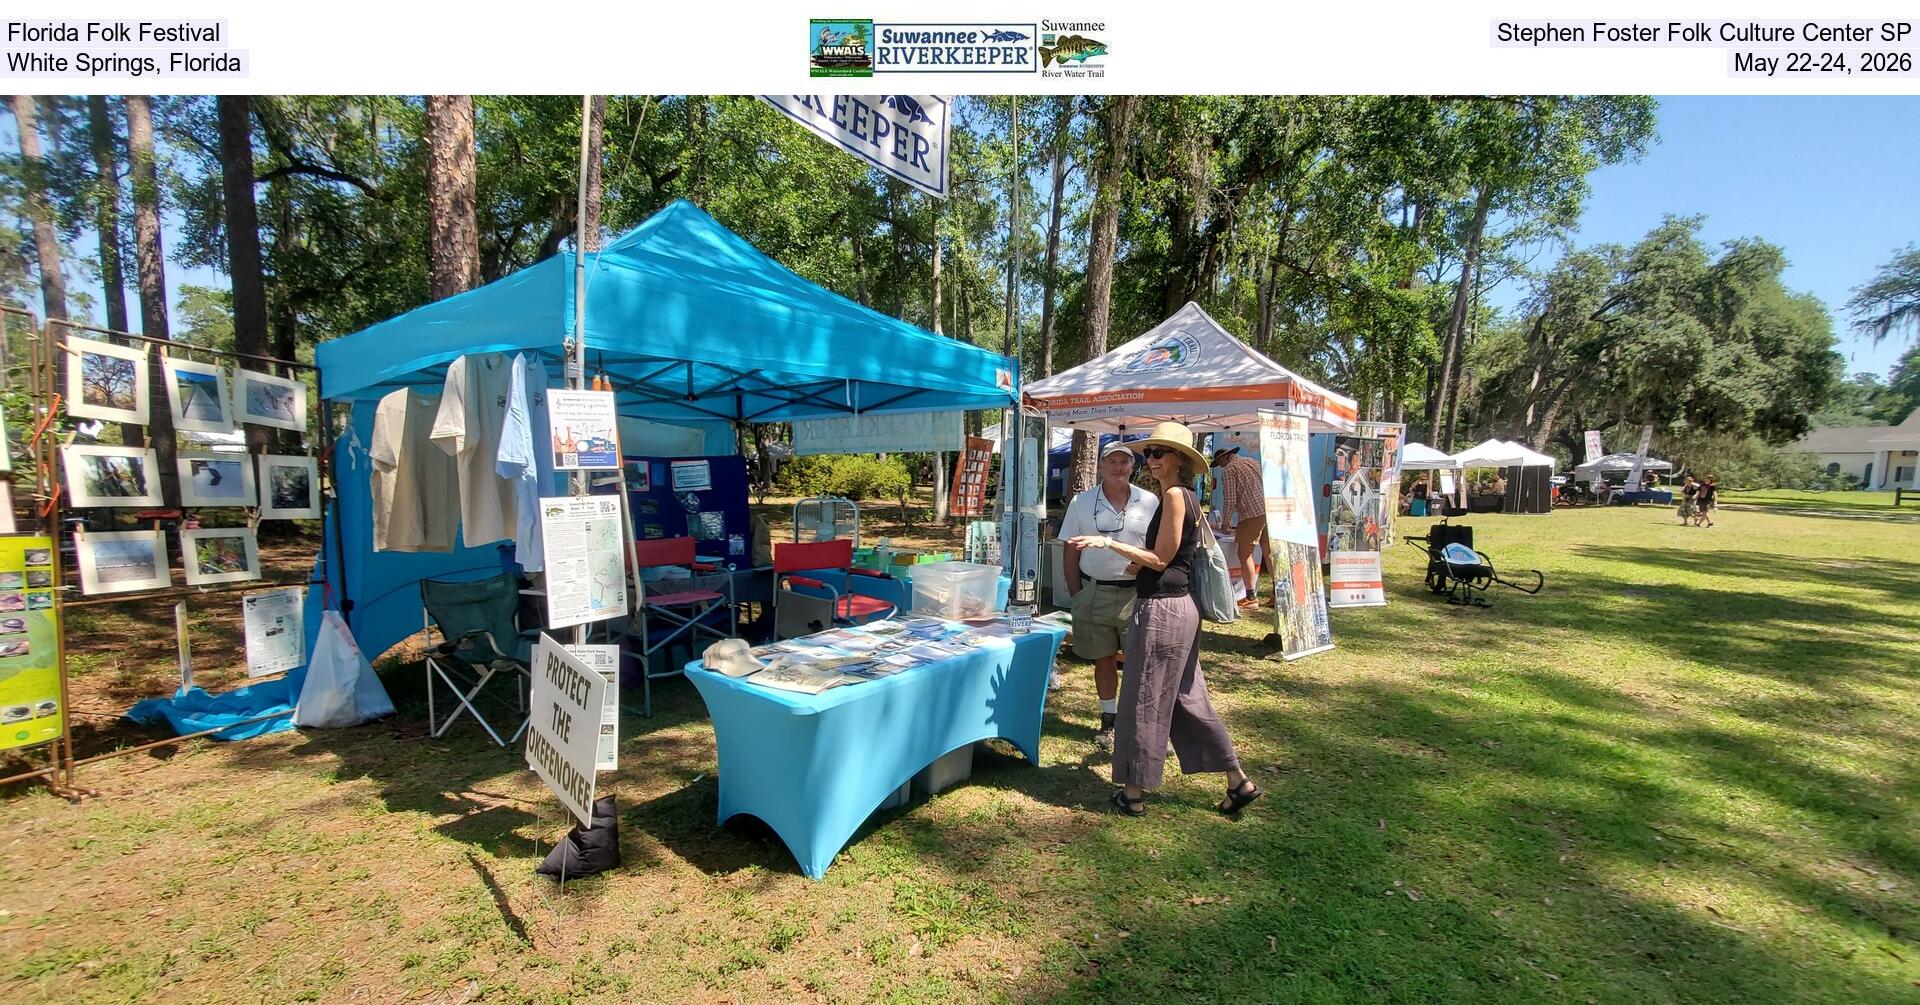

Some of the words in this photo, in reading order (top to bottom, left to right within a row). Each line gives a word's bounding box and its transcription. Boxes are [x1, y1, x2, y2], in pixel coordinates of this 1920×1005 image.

[1090, 407, 1107, 415] Than
[1108, 405, 1125, 414] Trails
[1093, 392, 1145, 403] ASSOCIATION
[1270, 431, 1293, 441] FLORIDA
[545, 650, 592, 710] PROTECT
[551, 702, 572, 744] THE
[528, 725, 591, 813] OKEFENOKEE
